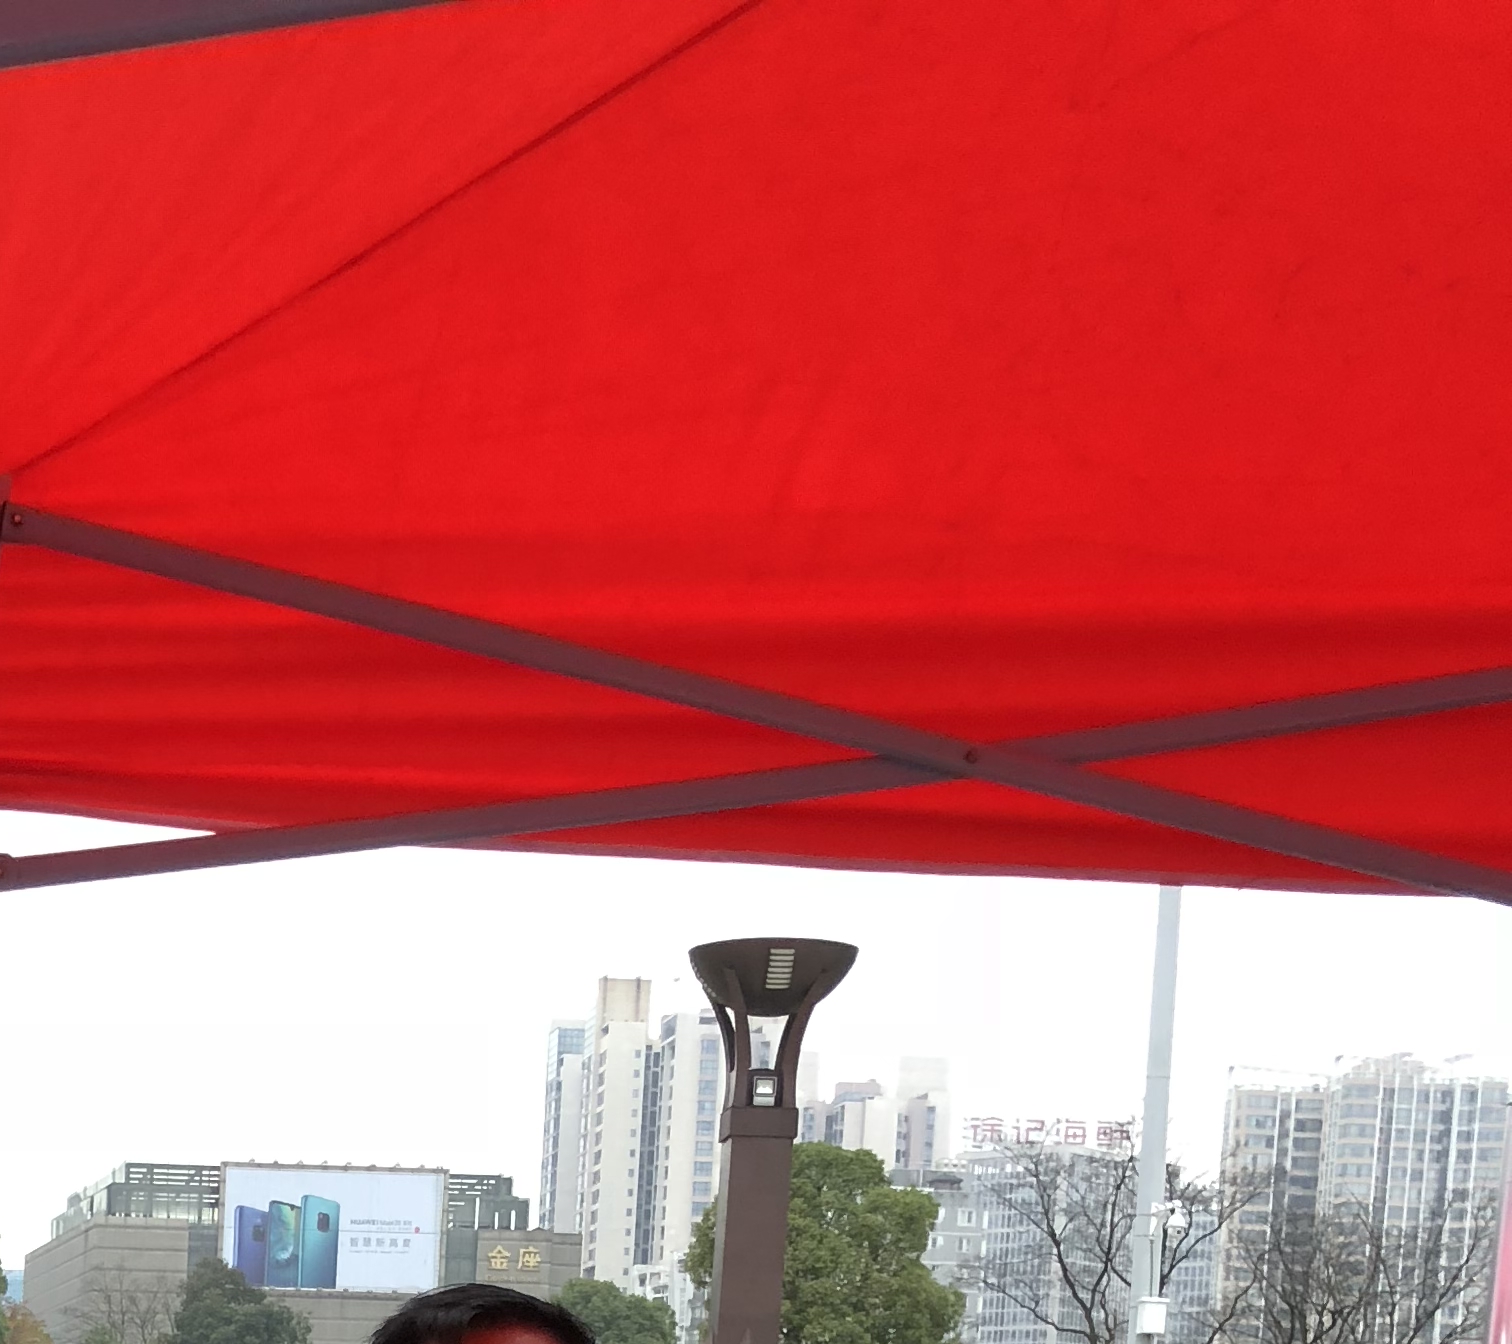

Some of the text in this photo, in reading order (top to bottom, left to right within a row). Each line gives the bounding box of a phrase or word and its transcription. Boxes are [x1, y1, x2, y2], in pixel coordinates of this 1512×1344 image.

[962, 1115, 1134, 1151] 徐记海鲜
[487, 1244, 542, 1272] 金座
